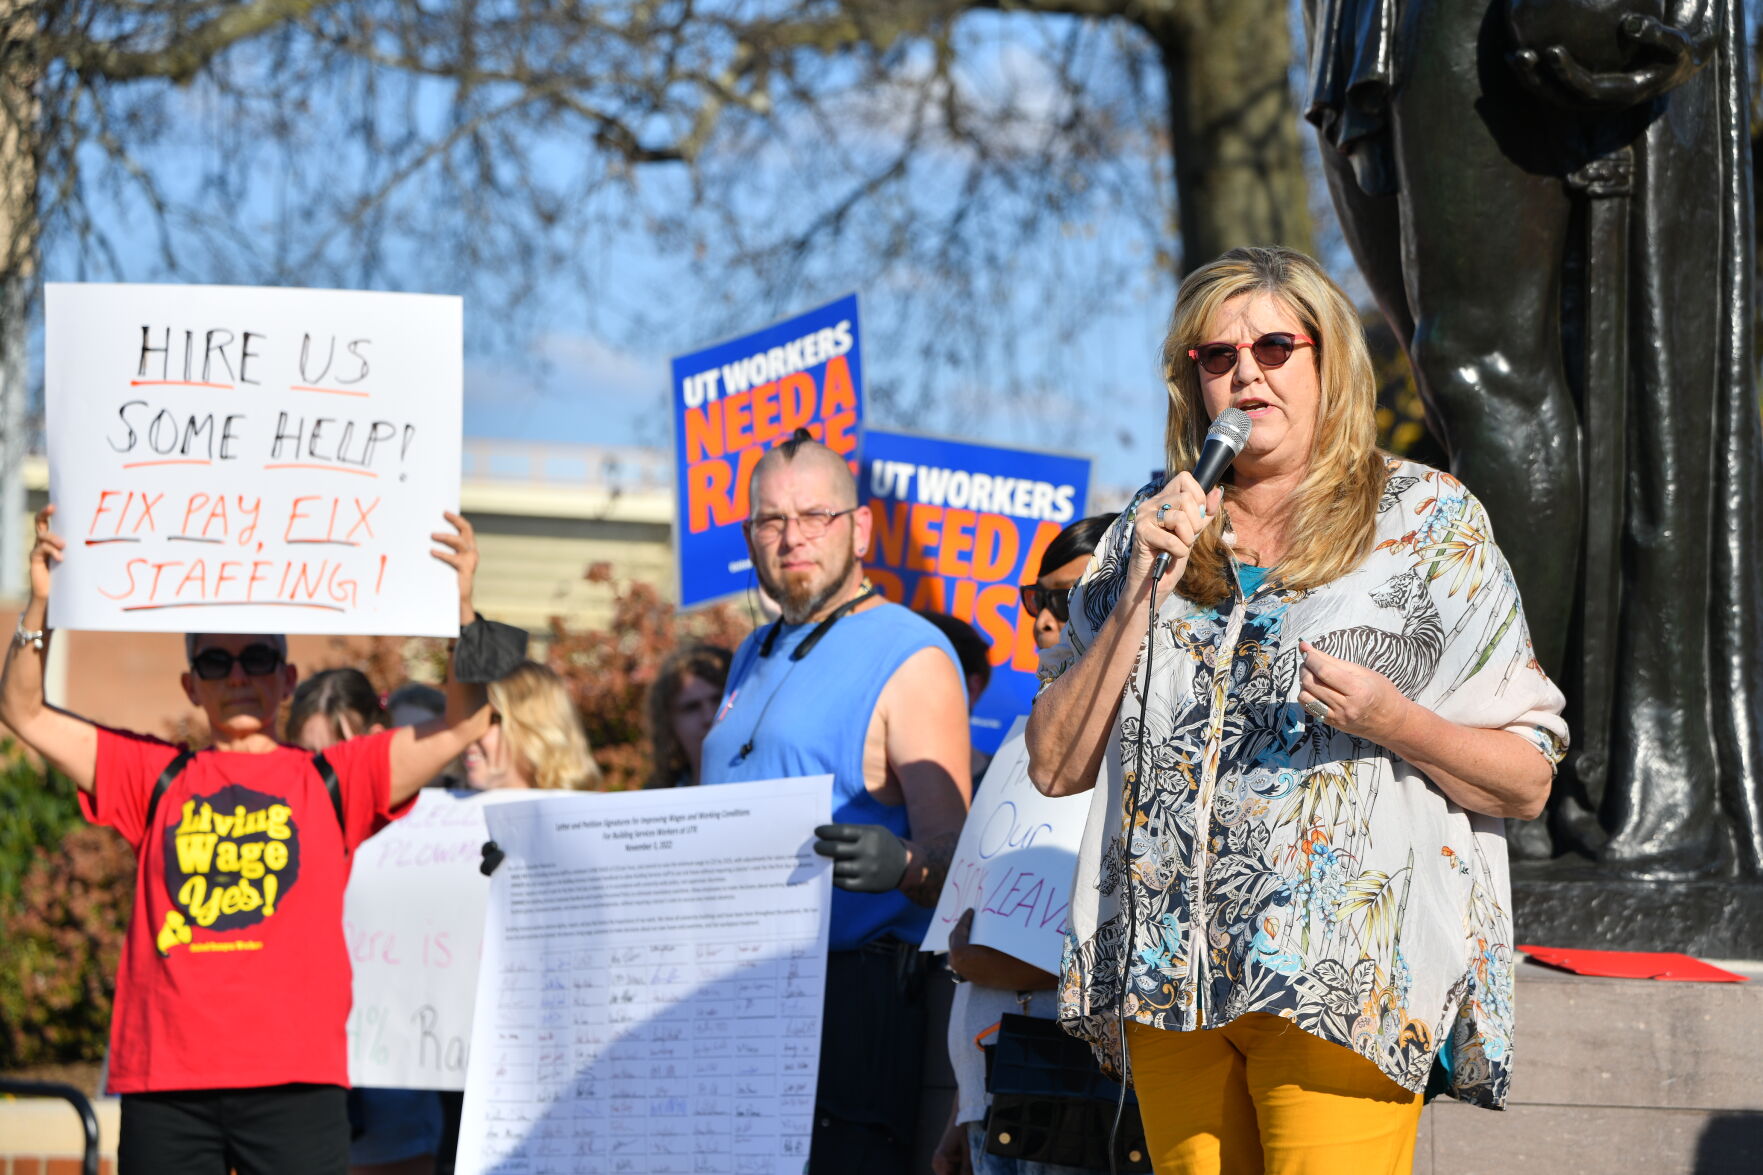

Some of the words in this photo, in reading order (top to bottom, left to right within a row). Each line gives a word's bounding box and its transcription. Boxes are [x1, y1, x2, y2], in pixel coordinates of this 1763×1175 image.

[137, 325, 268, 386] HIRE
[299, 332, 373, 386] US
[682, 368, 721, 409] UT
[721, 319, 854, 396] WORKERS
[684, 371, 818, 465] NEED
[820, 354, 858, 420] A
[107, 401, 247, 461] SOME
[270, 410, 417, 482] HELP!
[88, 490, 166, 537] FIX
[284, 496, 382, 542] FIX
[871, 459, 916, 500] UT
[916, 465, 1076, 523] WORKERS
[863, 498, 1020, 582] NEED
[98, 554, 389, 609] STAFFING!
[175, 799, 293, 840] Living
[979, 800, 1053, 860] Our
[175, 832, 289, 880] Wage
[178, 873, 279, 927] Yes!
[422, 917, 454, 969] is
